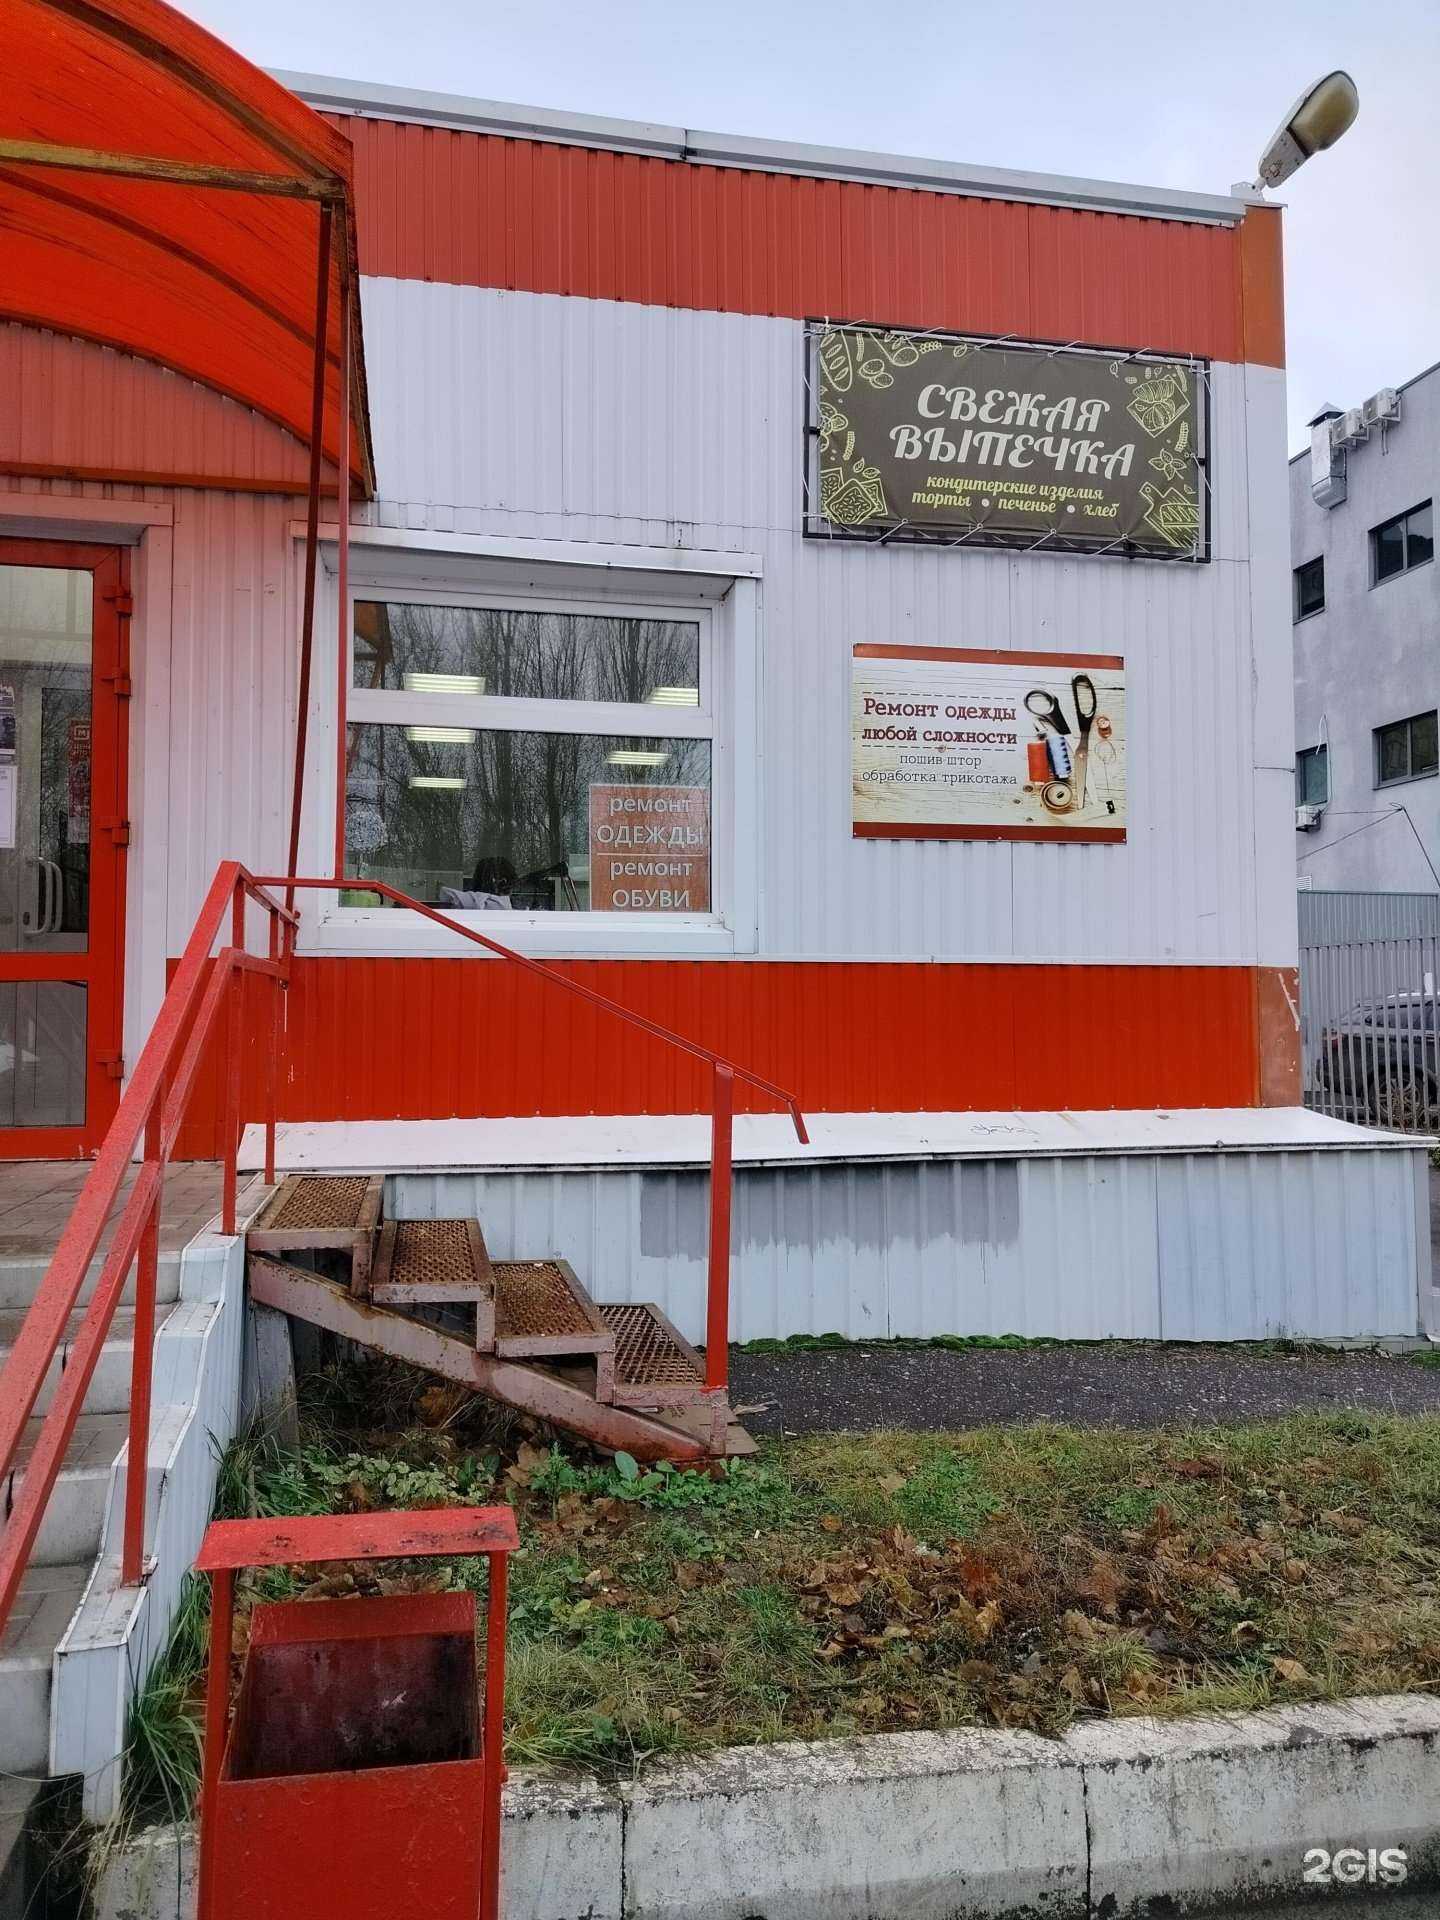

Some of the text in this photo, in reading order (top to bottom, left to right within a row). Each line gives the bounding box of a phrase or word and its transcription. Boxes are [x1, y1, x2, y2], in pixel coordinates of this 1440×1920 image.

[917, 384, 1110, 432] СВЕЖАЯ
[889, 424, 1136, 480] ВЫПЕЧКА
[926, 476, 1105, 501] кондитерские изделия
[911, 491, 1120, 518] торты печенье хлеб
[863, 698, 1016, 721] Ремонт одежды
[862, 726, 1017, 745] любой сложности
[900, 754, 982, 769] пошив штор
[862, 770, 1017, 786] обработка трикотажа
[610, 797, 692, 816] ремонт
[596, 825, 704, 848] ОДЕЖДЫ
[610, 861, 693, 881] ремонт
[612, 889, 690, 908] ОБУВИ
